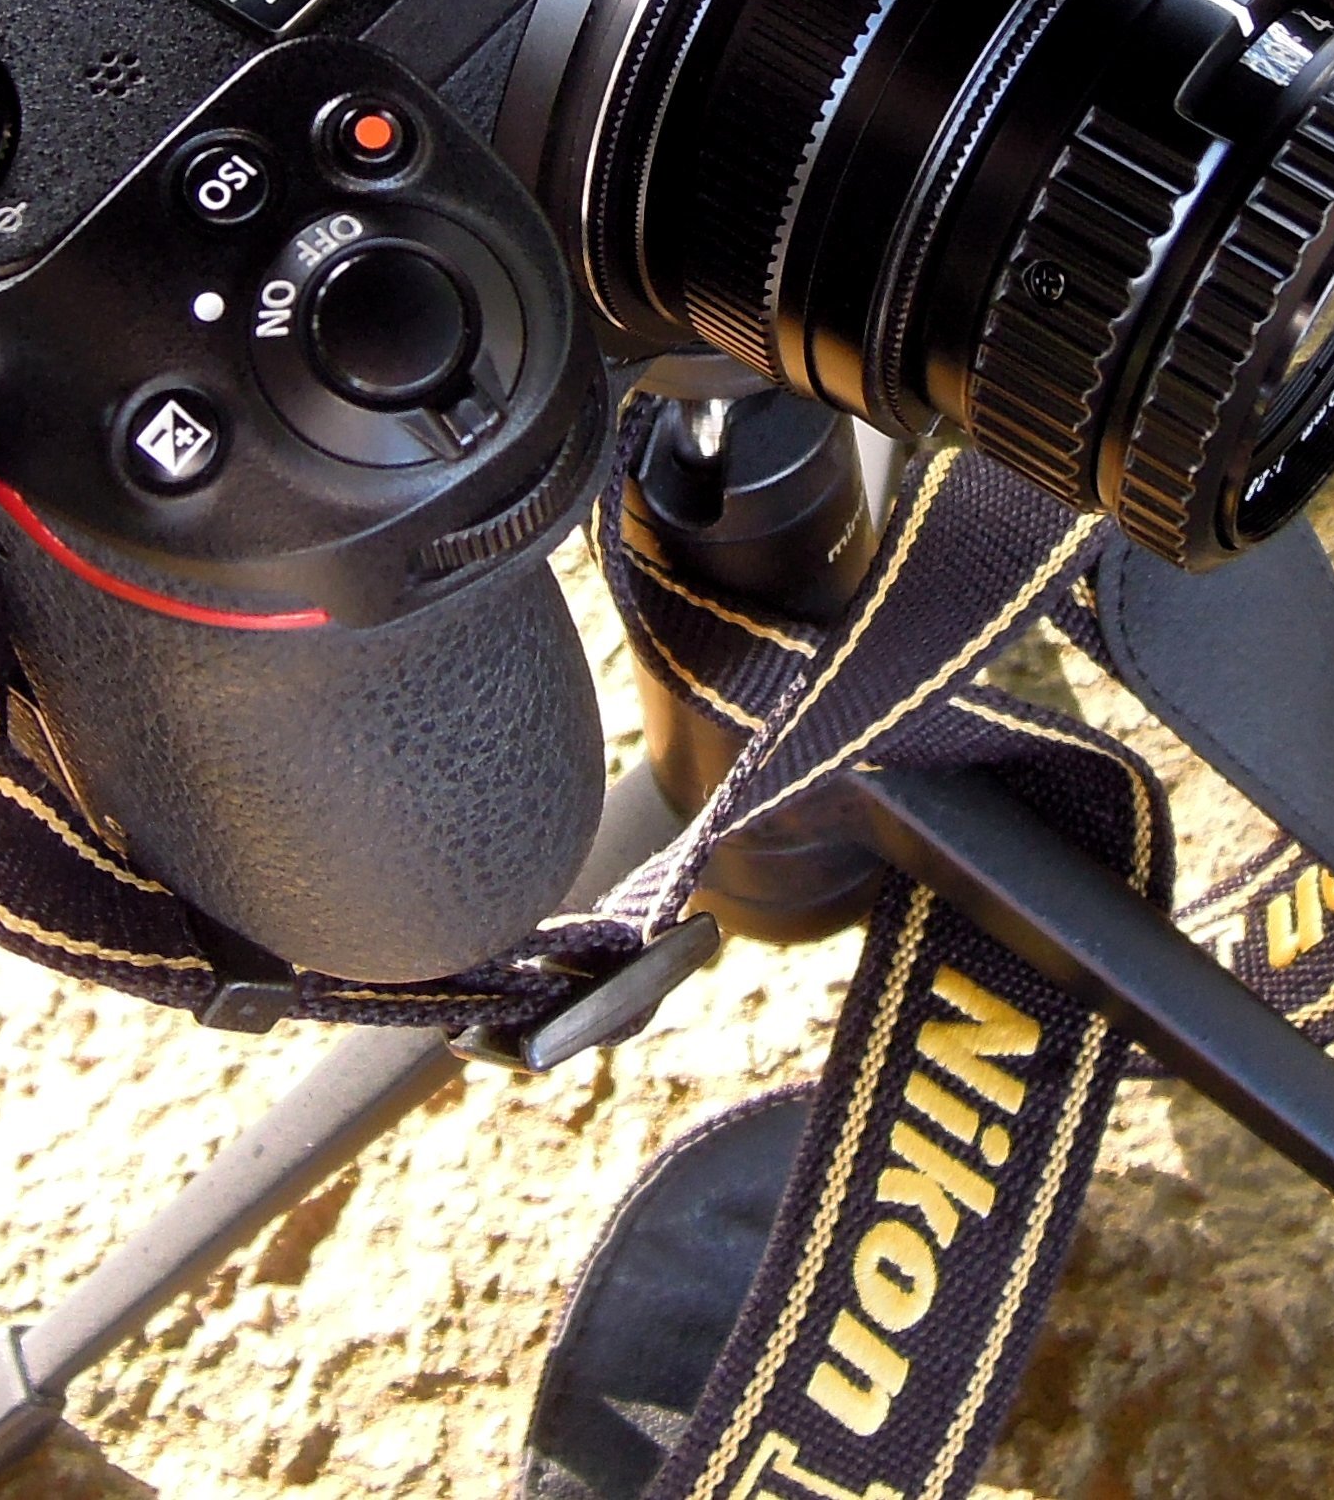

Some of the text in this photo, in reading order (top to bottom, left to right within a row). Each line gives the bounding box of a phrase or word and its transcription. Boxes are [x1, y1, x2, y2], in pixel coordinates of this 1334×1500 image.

[197, 155, 258, 210] ISO
[295, 213, 364, 267] OFF
[254, 279, 297, 338] ON
[806, 964, 1043, 1437] Nikon
